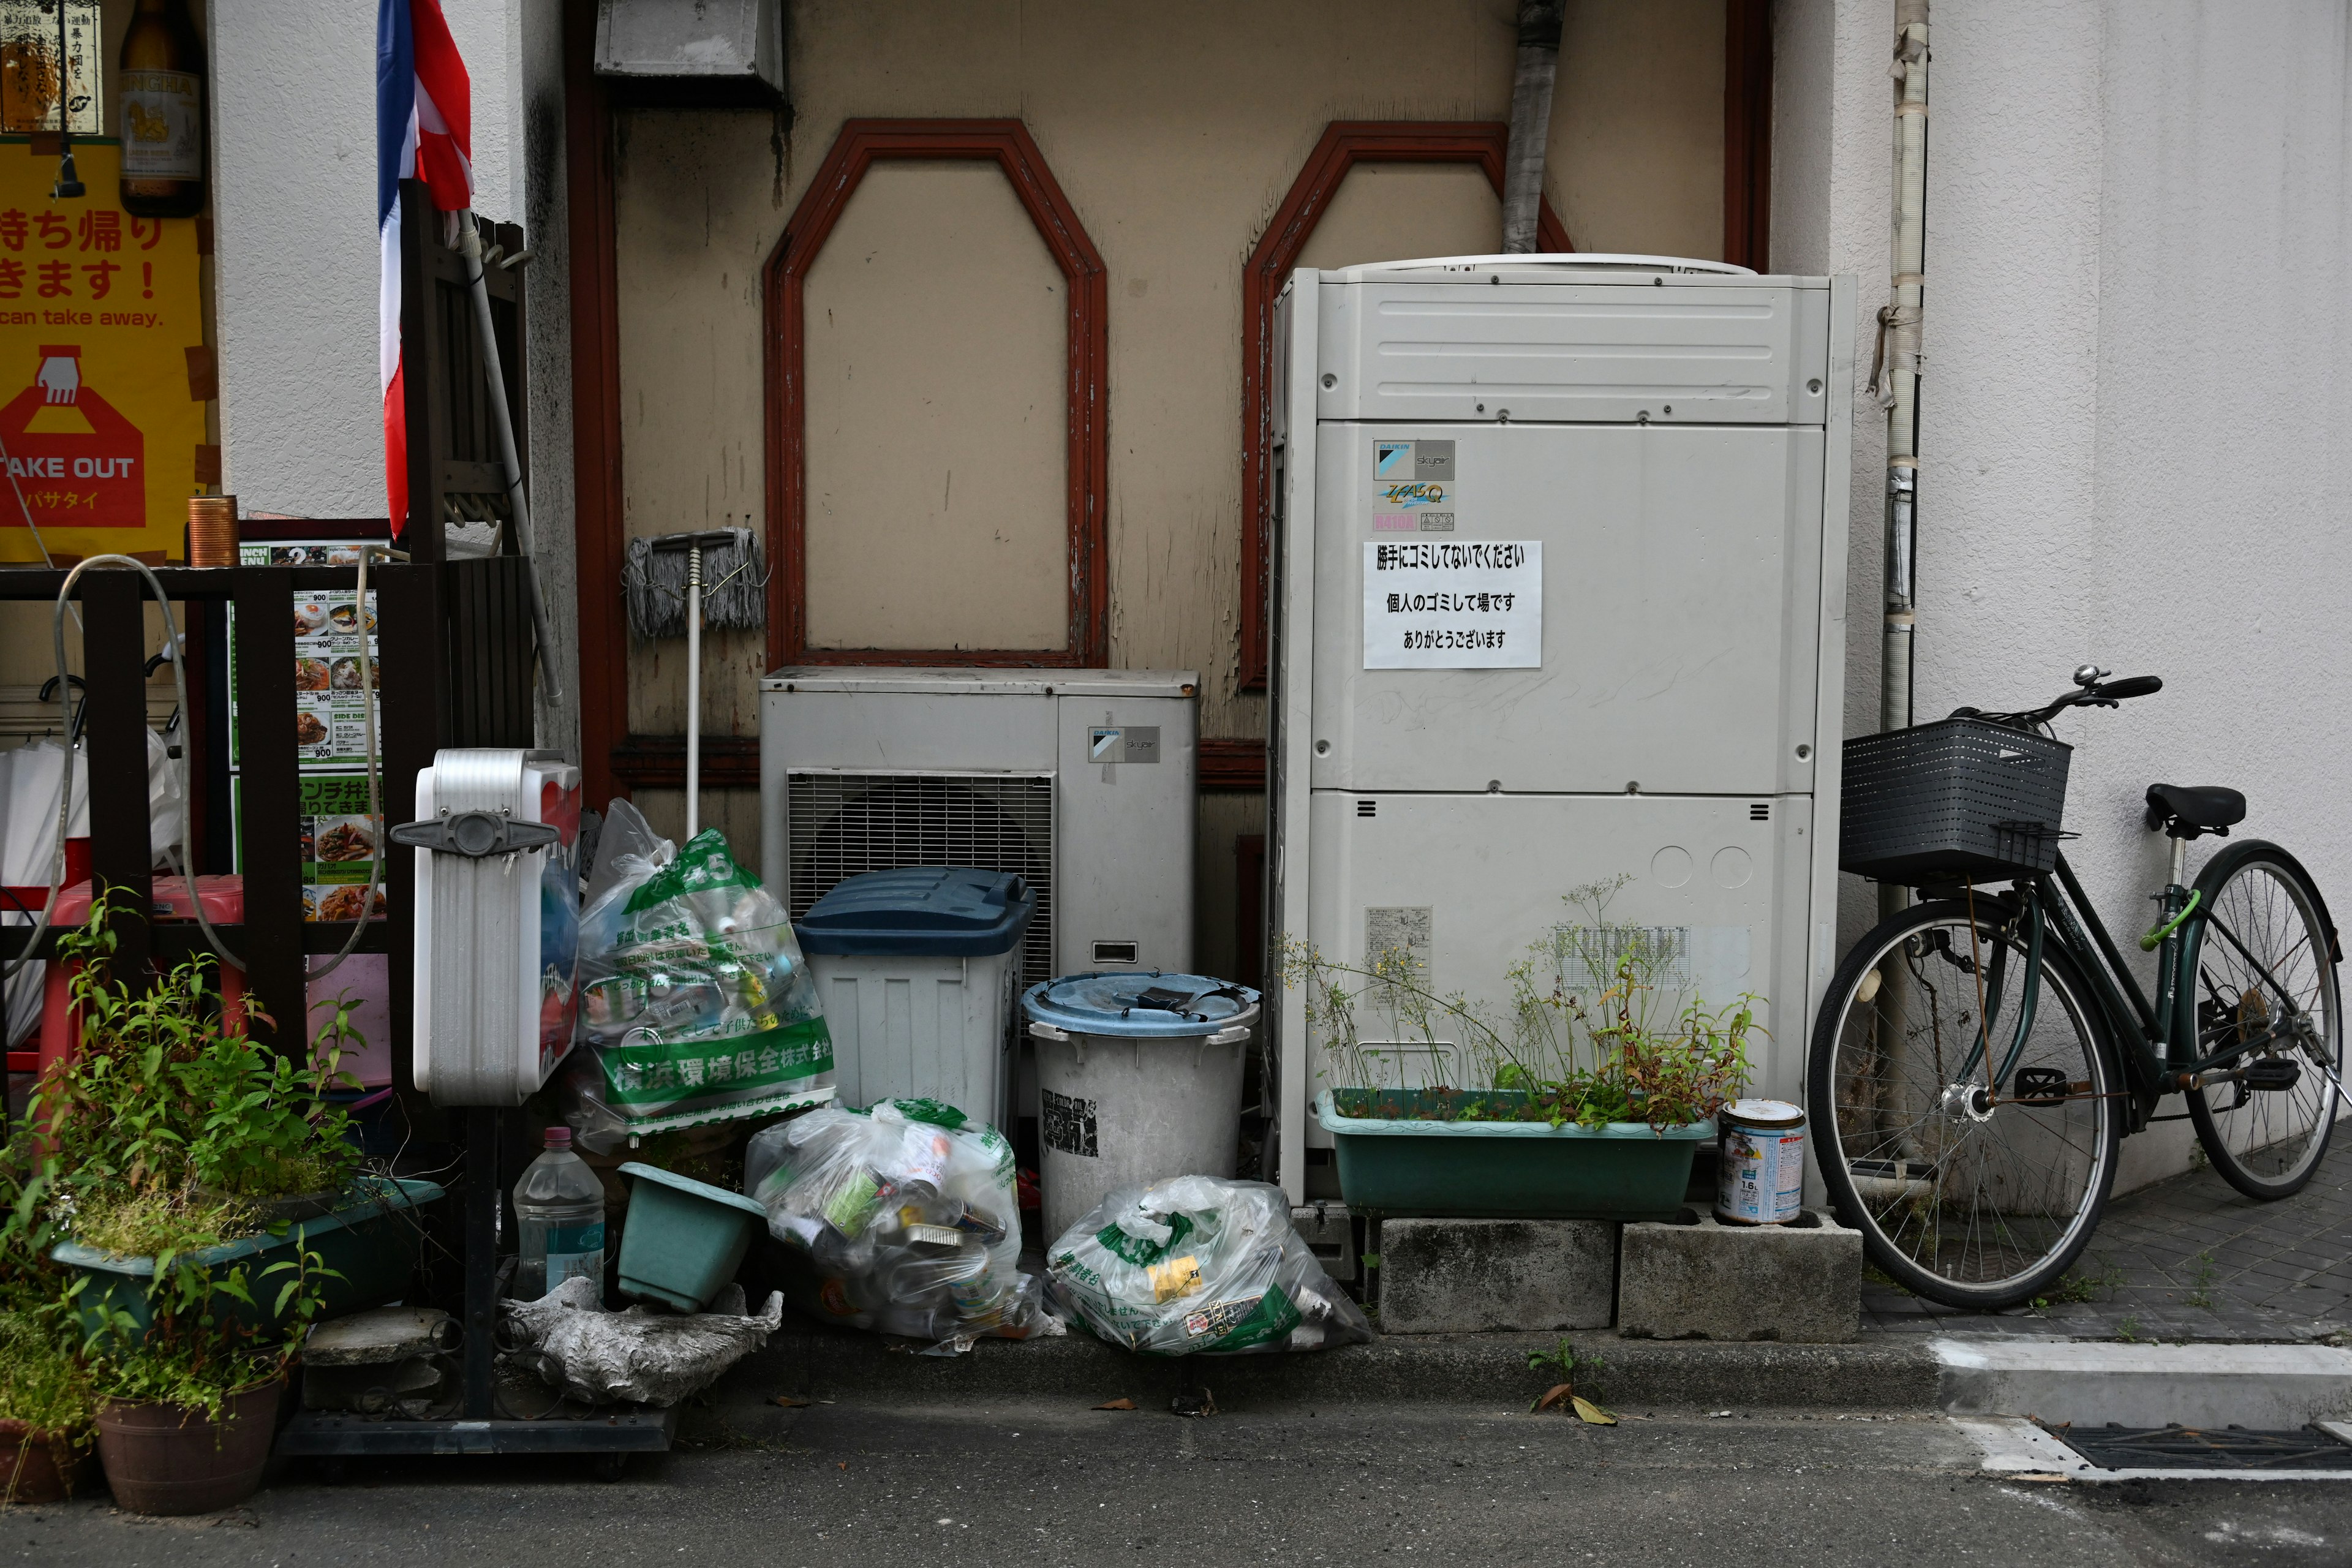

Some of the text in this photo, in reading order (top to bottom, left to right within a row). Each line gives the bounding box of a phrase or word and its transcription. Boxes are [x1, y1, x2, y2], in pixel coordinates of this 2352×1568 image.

[70, 28, 83, 80] 暴力団を
[0, 208, 162, 252] 持ち帰り
[0, 309, 164, 328] can take away.
[74, 458, 134, 479] OUT
[26, 491, 99, 510] パサタイ
[1375, 514, 1414, 529] R410A
[1387, 593, 1515, 613] 個人のゴミして場です
[1403, 630, 1506, 649] ありがとうございます
[613, 1037, 833, 1093] 横浜環境保全株式会社
